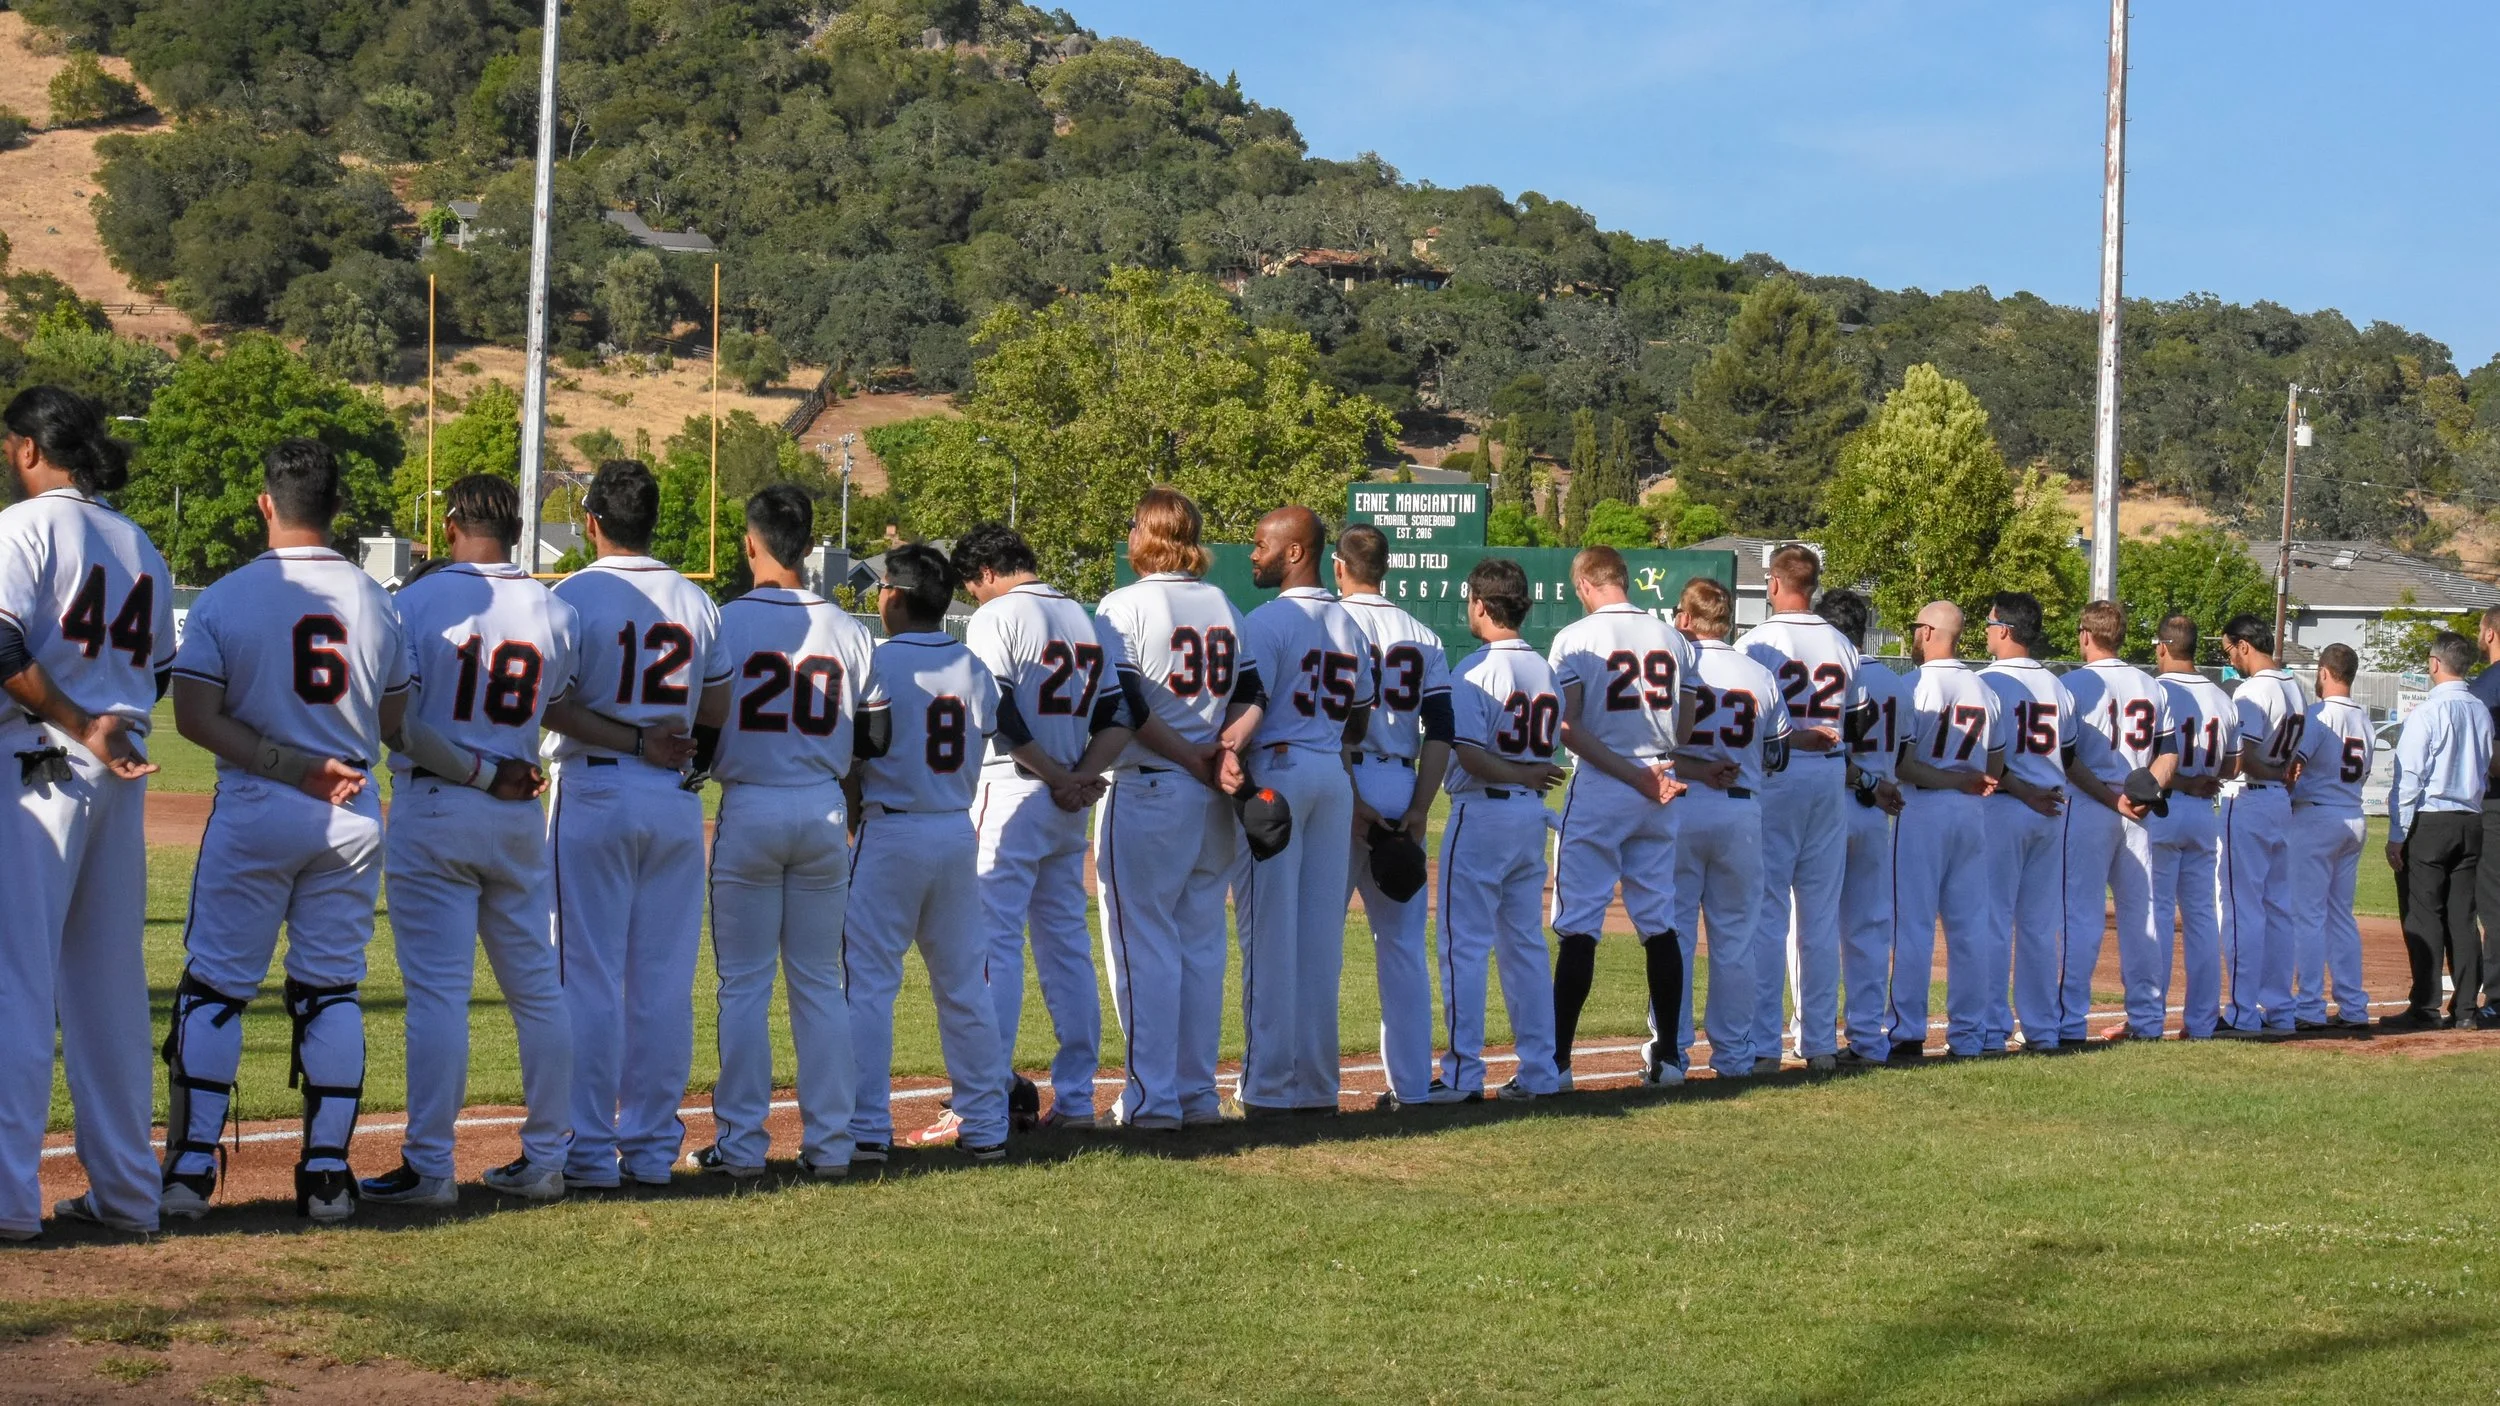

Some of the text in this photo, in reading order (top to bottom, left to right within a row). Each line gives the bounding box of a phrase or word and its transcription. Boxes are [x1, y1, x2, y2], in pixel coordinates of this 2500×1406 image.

[1355, 493, 1476, 512] ERNIE MANGIANTINI
[1374, 514, 1456, 527] MEMORIAL SCOREBOARD
[1396, 527, 1432, 539] EST. 2016
[1420, 553, 1448, 569] FIELD
[61, 563, 154, 668] 44
[1399, 580, 1407, 597] 5
[1420, 580, 1427, 598] 6
[1440, 581, 1448, 598] 7
[1460, 581, 1468, 599] 8
[1535, 583, 1543, 600] H
[1556, 583, 1564, 600] E
[292, 614, 350, 705] 6
[455, 634, 545, 728] 18
[617, 620, 694, 706] 12
[1038, 640, 1104, 718] 27
[1168, 625, 1236, 698] 38
[1294, 649, 1359, 723] 35
[1606, 650, 1677, 712] 29
[1778, 660, 1846, 719] 22
[739, 651, 844, 737] 20
[1686, 686, 1759, 750] 23
[925, 694, 966, 774] 8
[1497, 691, 1561, 758] 30
[1931, 704, 1987, 760] 17
[2014, 700, 2058, 756] 15
[2107, 698, 2155, 752] 13
[2181, 716, 2220, 768] 11
[2269, 713, 2305, 761] 10
[2340, 736, 2365, 784] 5
